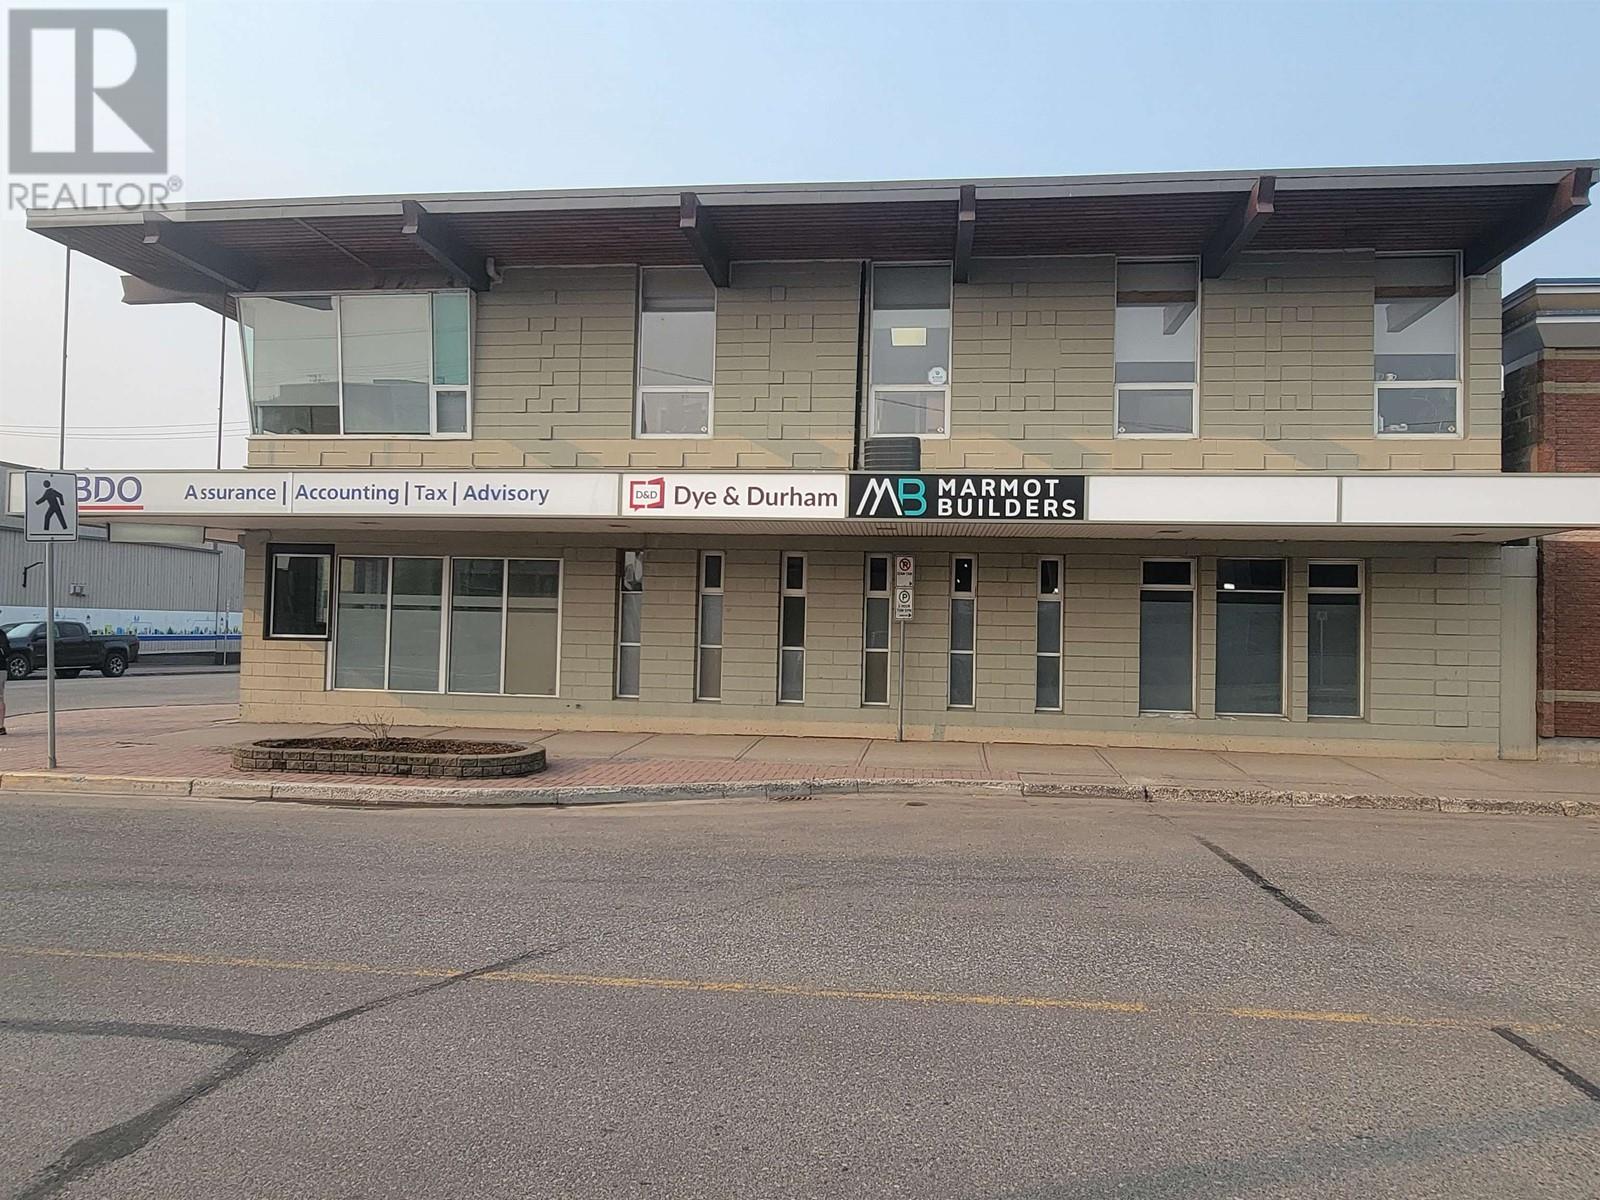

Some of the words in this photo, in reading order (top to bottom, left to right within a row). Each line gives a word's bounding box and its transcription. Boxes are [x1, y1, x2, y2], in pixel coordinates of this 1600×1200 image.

[77, 476, 142, 502] BDO
[184, 484, 277, 500] Assurance
[295, 484, 399, 504] Accounting
[414, 485, 448, 501] Tax
[463, 484, 549, 505] Advisory
[635, 490, 658, 499] D&D
[674, 486, 717, 509] Dye
[723, 486, 740, 506] &
[747, 486, 838, 507] Durham
[855, 478, 927, 516] MB
[938, 478, 1060, 497] MARMOT
[937, 498, 1077, 518] BUILDERS
